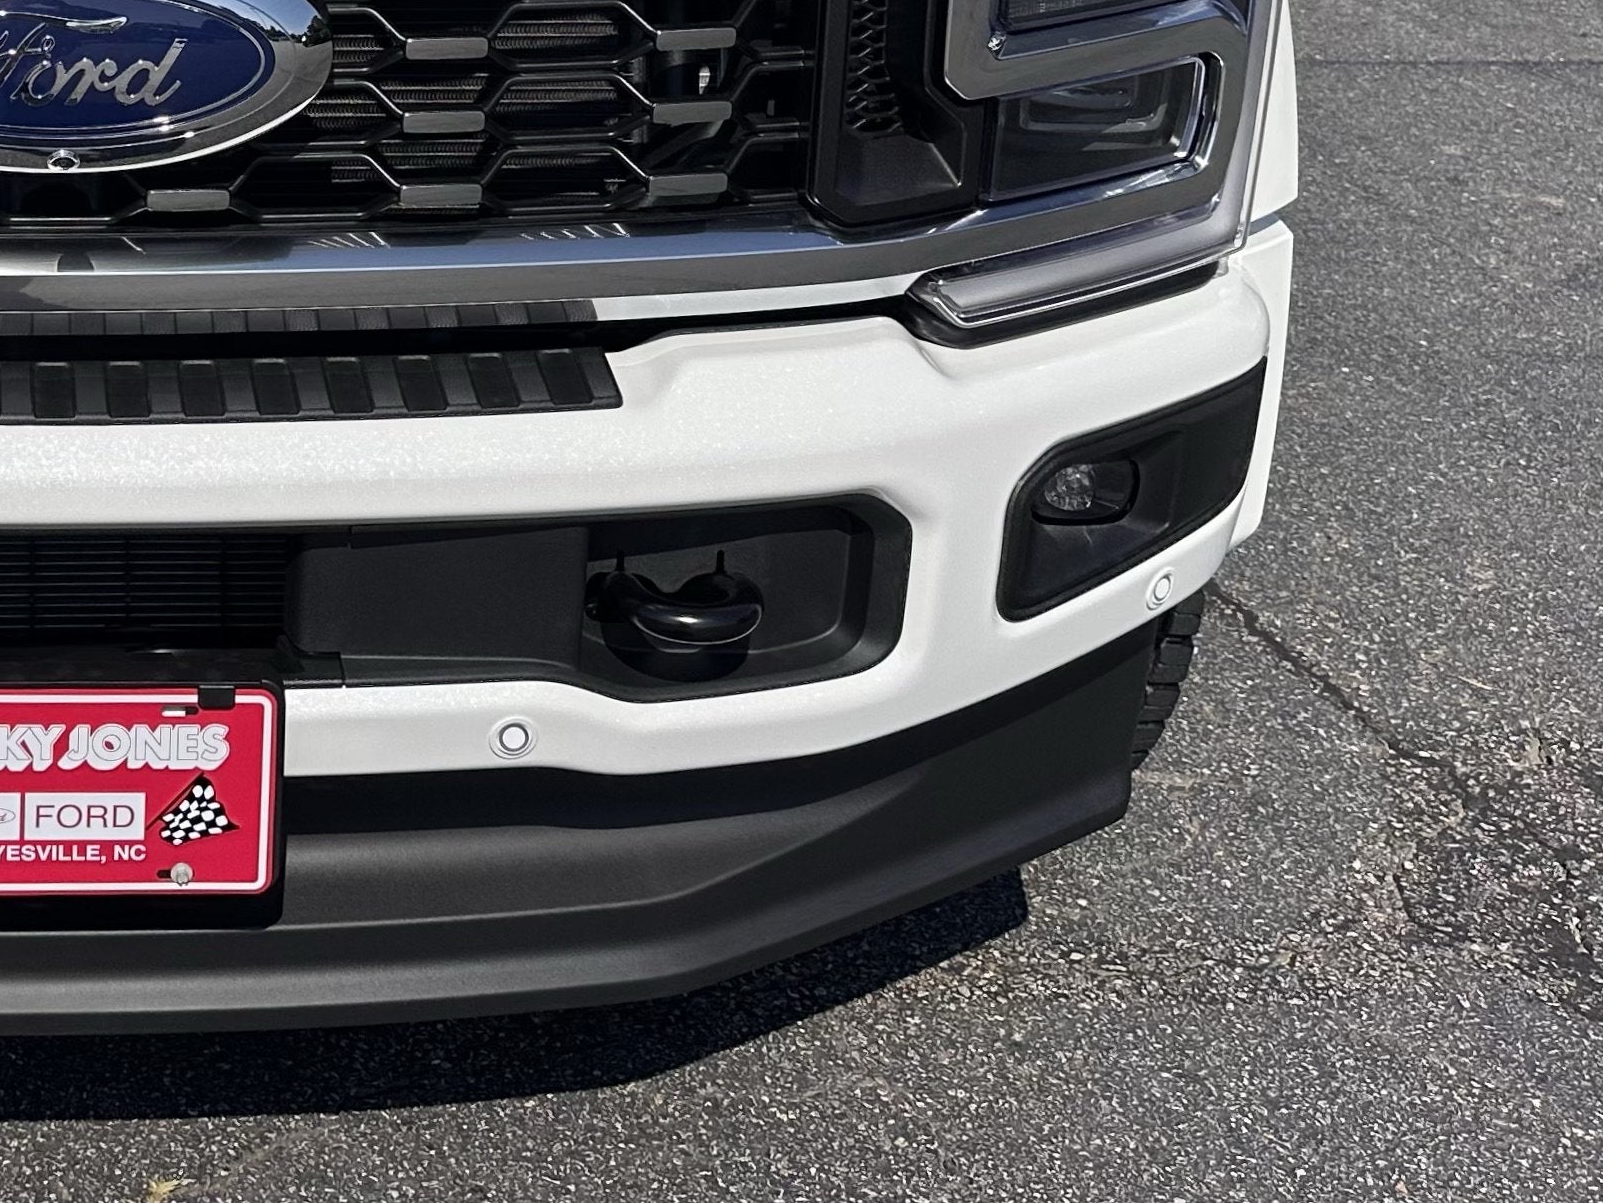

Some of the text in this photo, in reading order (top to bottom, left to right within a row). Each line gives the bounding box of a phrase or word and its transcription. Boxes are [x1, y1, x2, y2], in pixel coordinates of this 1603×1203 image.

[58, 723, 230, 771] JONES
[35, 804, 135, 829] FORD
[113, 845, 147, 862] NC
